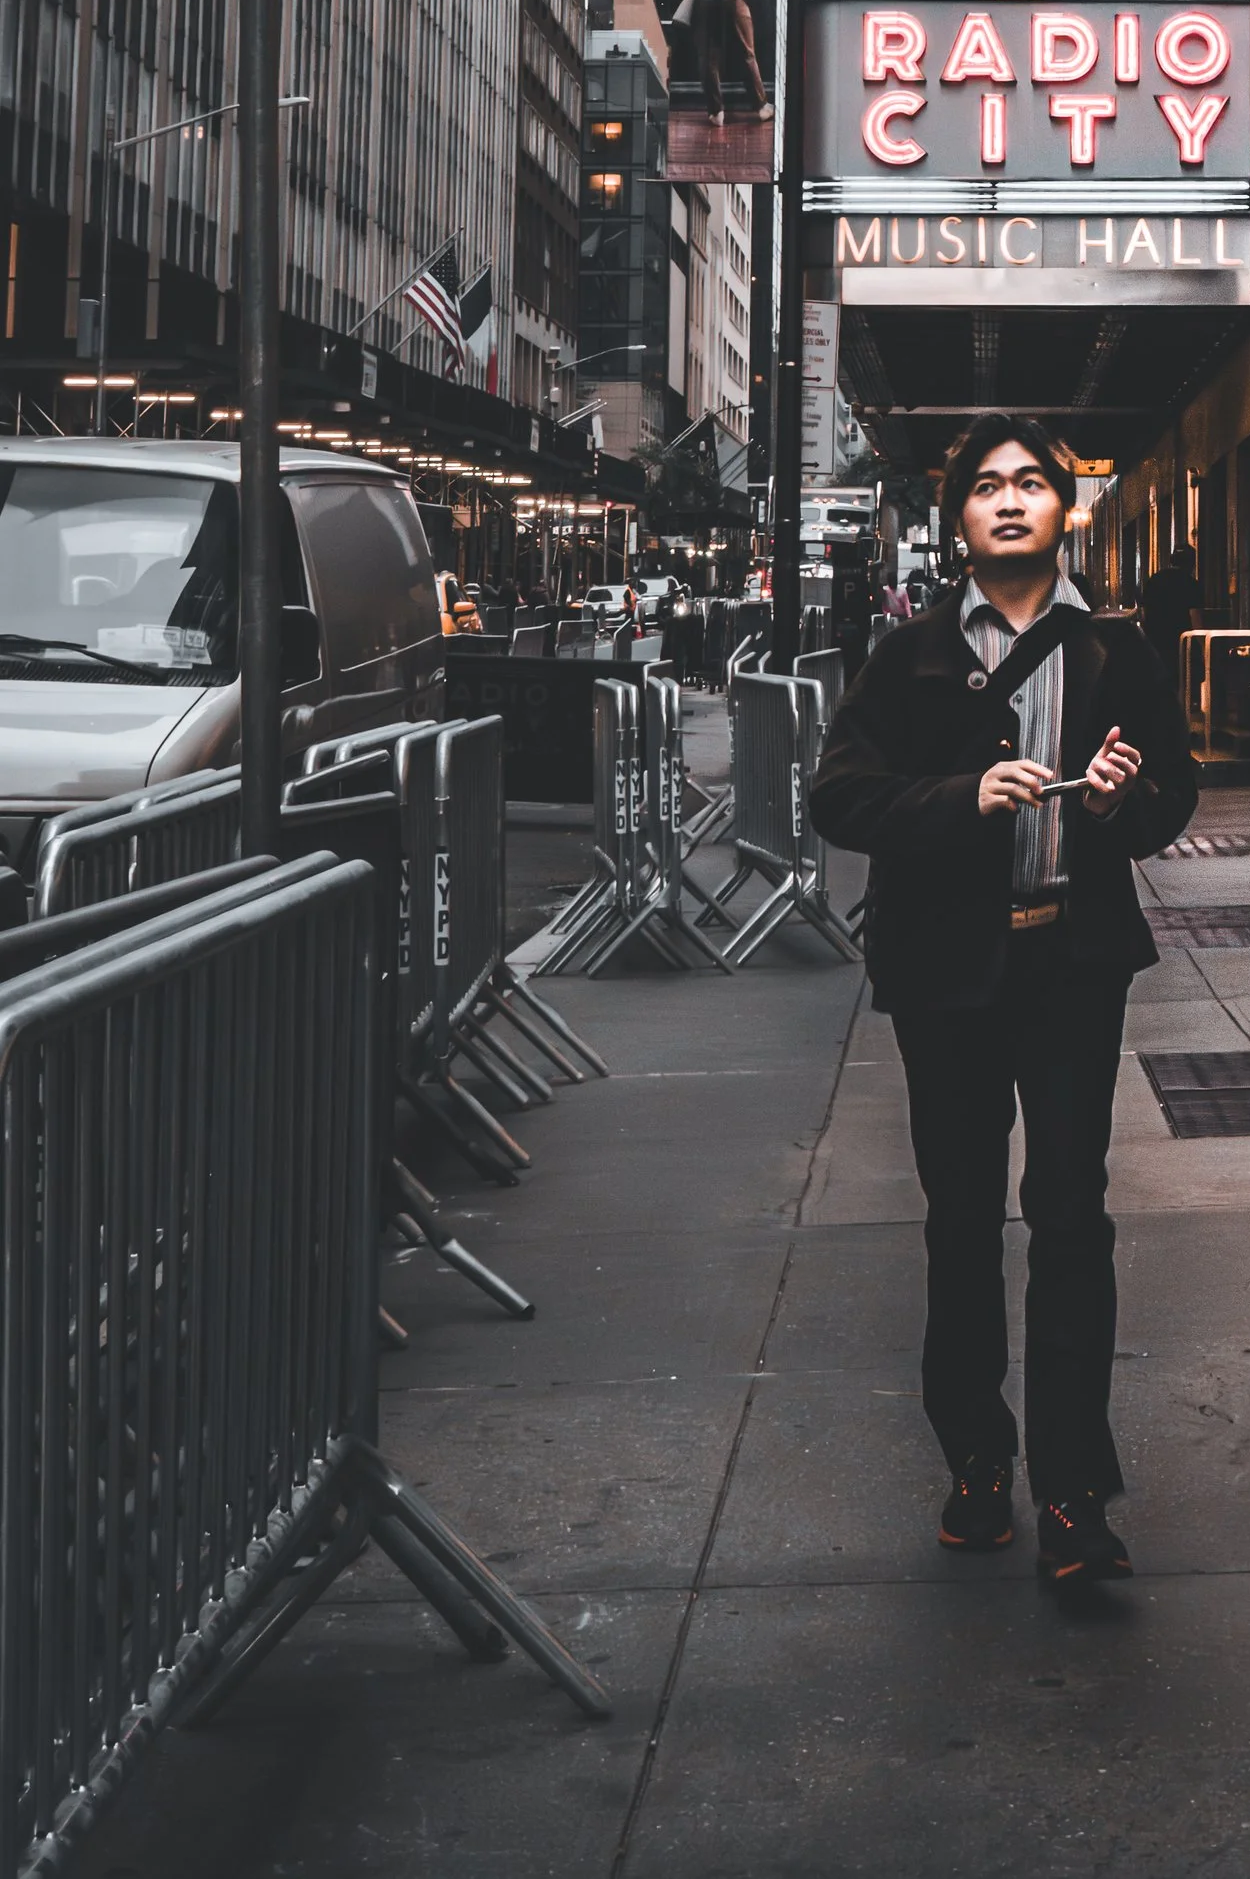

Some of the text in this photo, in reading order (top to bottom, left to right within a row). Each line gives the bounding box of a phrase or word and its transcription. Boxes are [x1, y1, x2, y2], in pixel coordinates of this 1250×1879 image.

[862, 10, 1232, 86] RADIO
[862, 89, 1232, 167] CITY
[836, 216, 1245, 267] MUSIC HALL
[617, 762, 626, 829] NYPD
[631, 760, 641, 827] NYPD
[672, 760, 682, 829] NYPD
[399, 859, 411, 968] NYPD
[437, 855, 451, 960] NYPD
